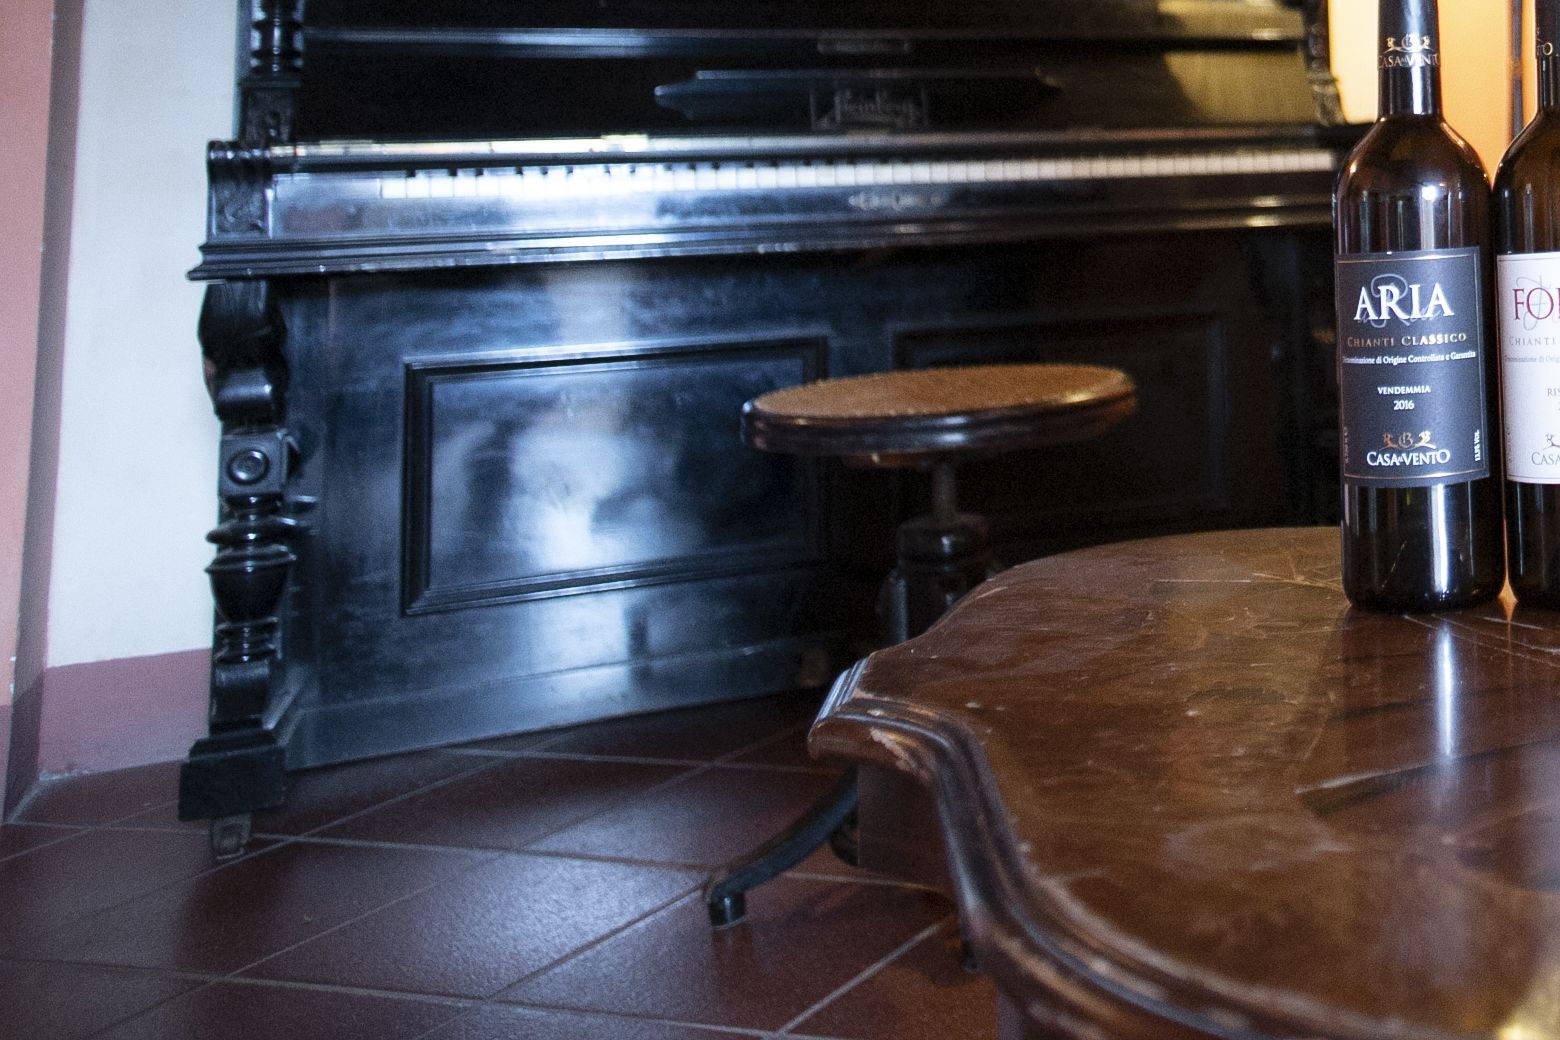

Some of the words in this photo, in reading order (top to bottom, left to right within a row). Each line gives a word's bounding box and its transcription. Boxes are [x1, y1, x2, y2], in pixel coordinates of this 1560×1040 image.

[1354, 282, 1455, 320] ARIA
[1347, 336, 1394, 348] CHIANTI
[1401, 332, 1467, 346] CLASSICO
[1509, 335, 1556, 346] CHIANTI
[1383, 355, 1407, 366] Origine
[1408, 353, 1445, 363] Controllata
[1377, 385, 1431, 395] VENDEMMIA
[1393, 400, 1415, 411] 2016
